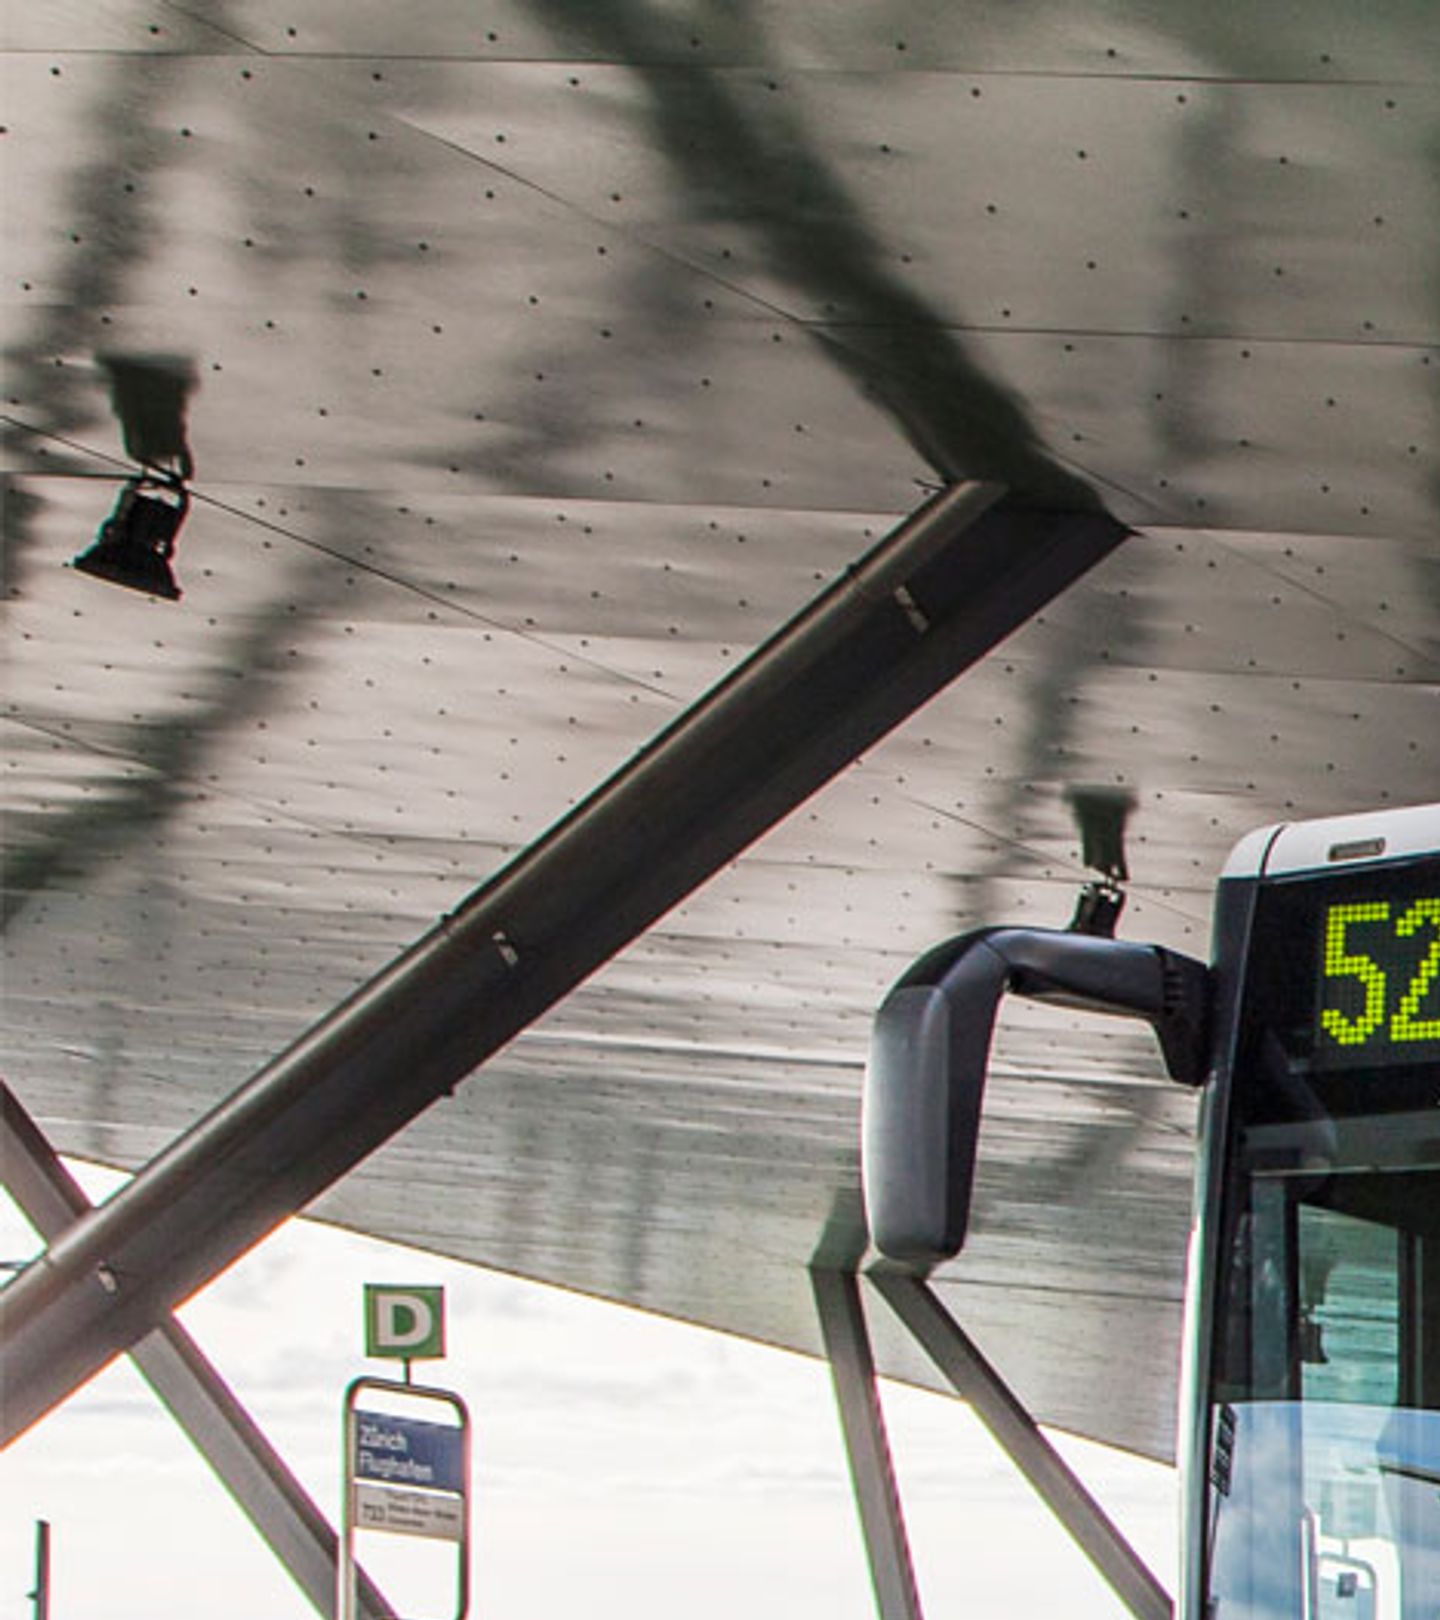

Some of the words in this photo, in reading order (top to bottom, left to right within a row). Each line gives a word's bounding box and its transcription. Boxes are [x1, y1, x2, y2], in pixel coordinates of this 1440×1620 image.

[376, 1295, 433, 1346] D
[360, 1424, 408, 1452] Zürich
[360, 1451, 433, 1482] Flughafen
